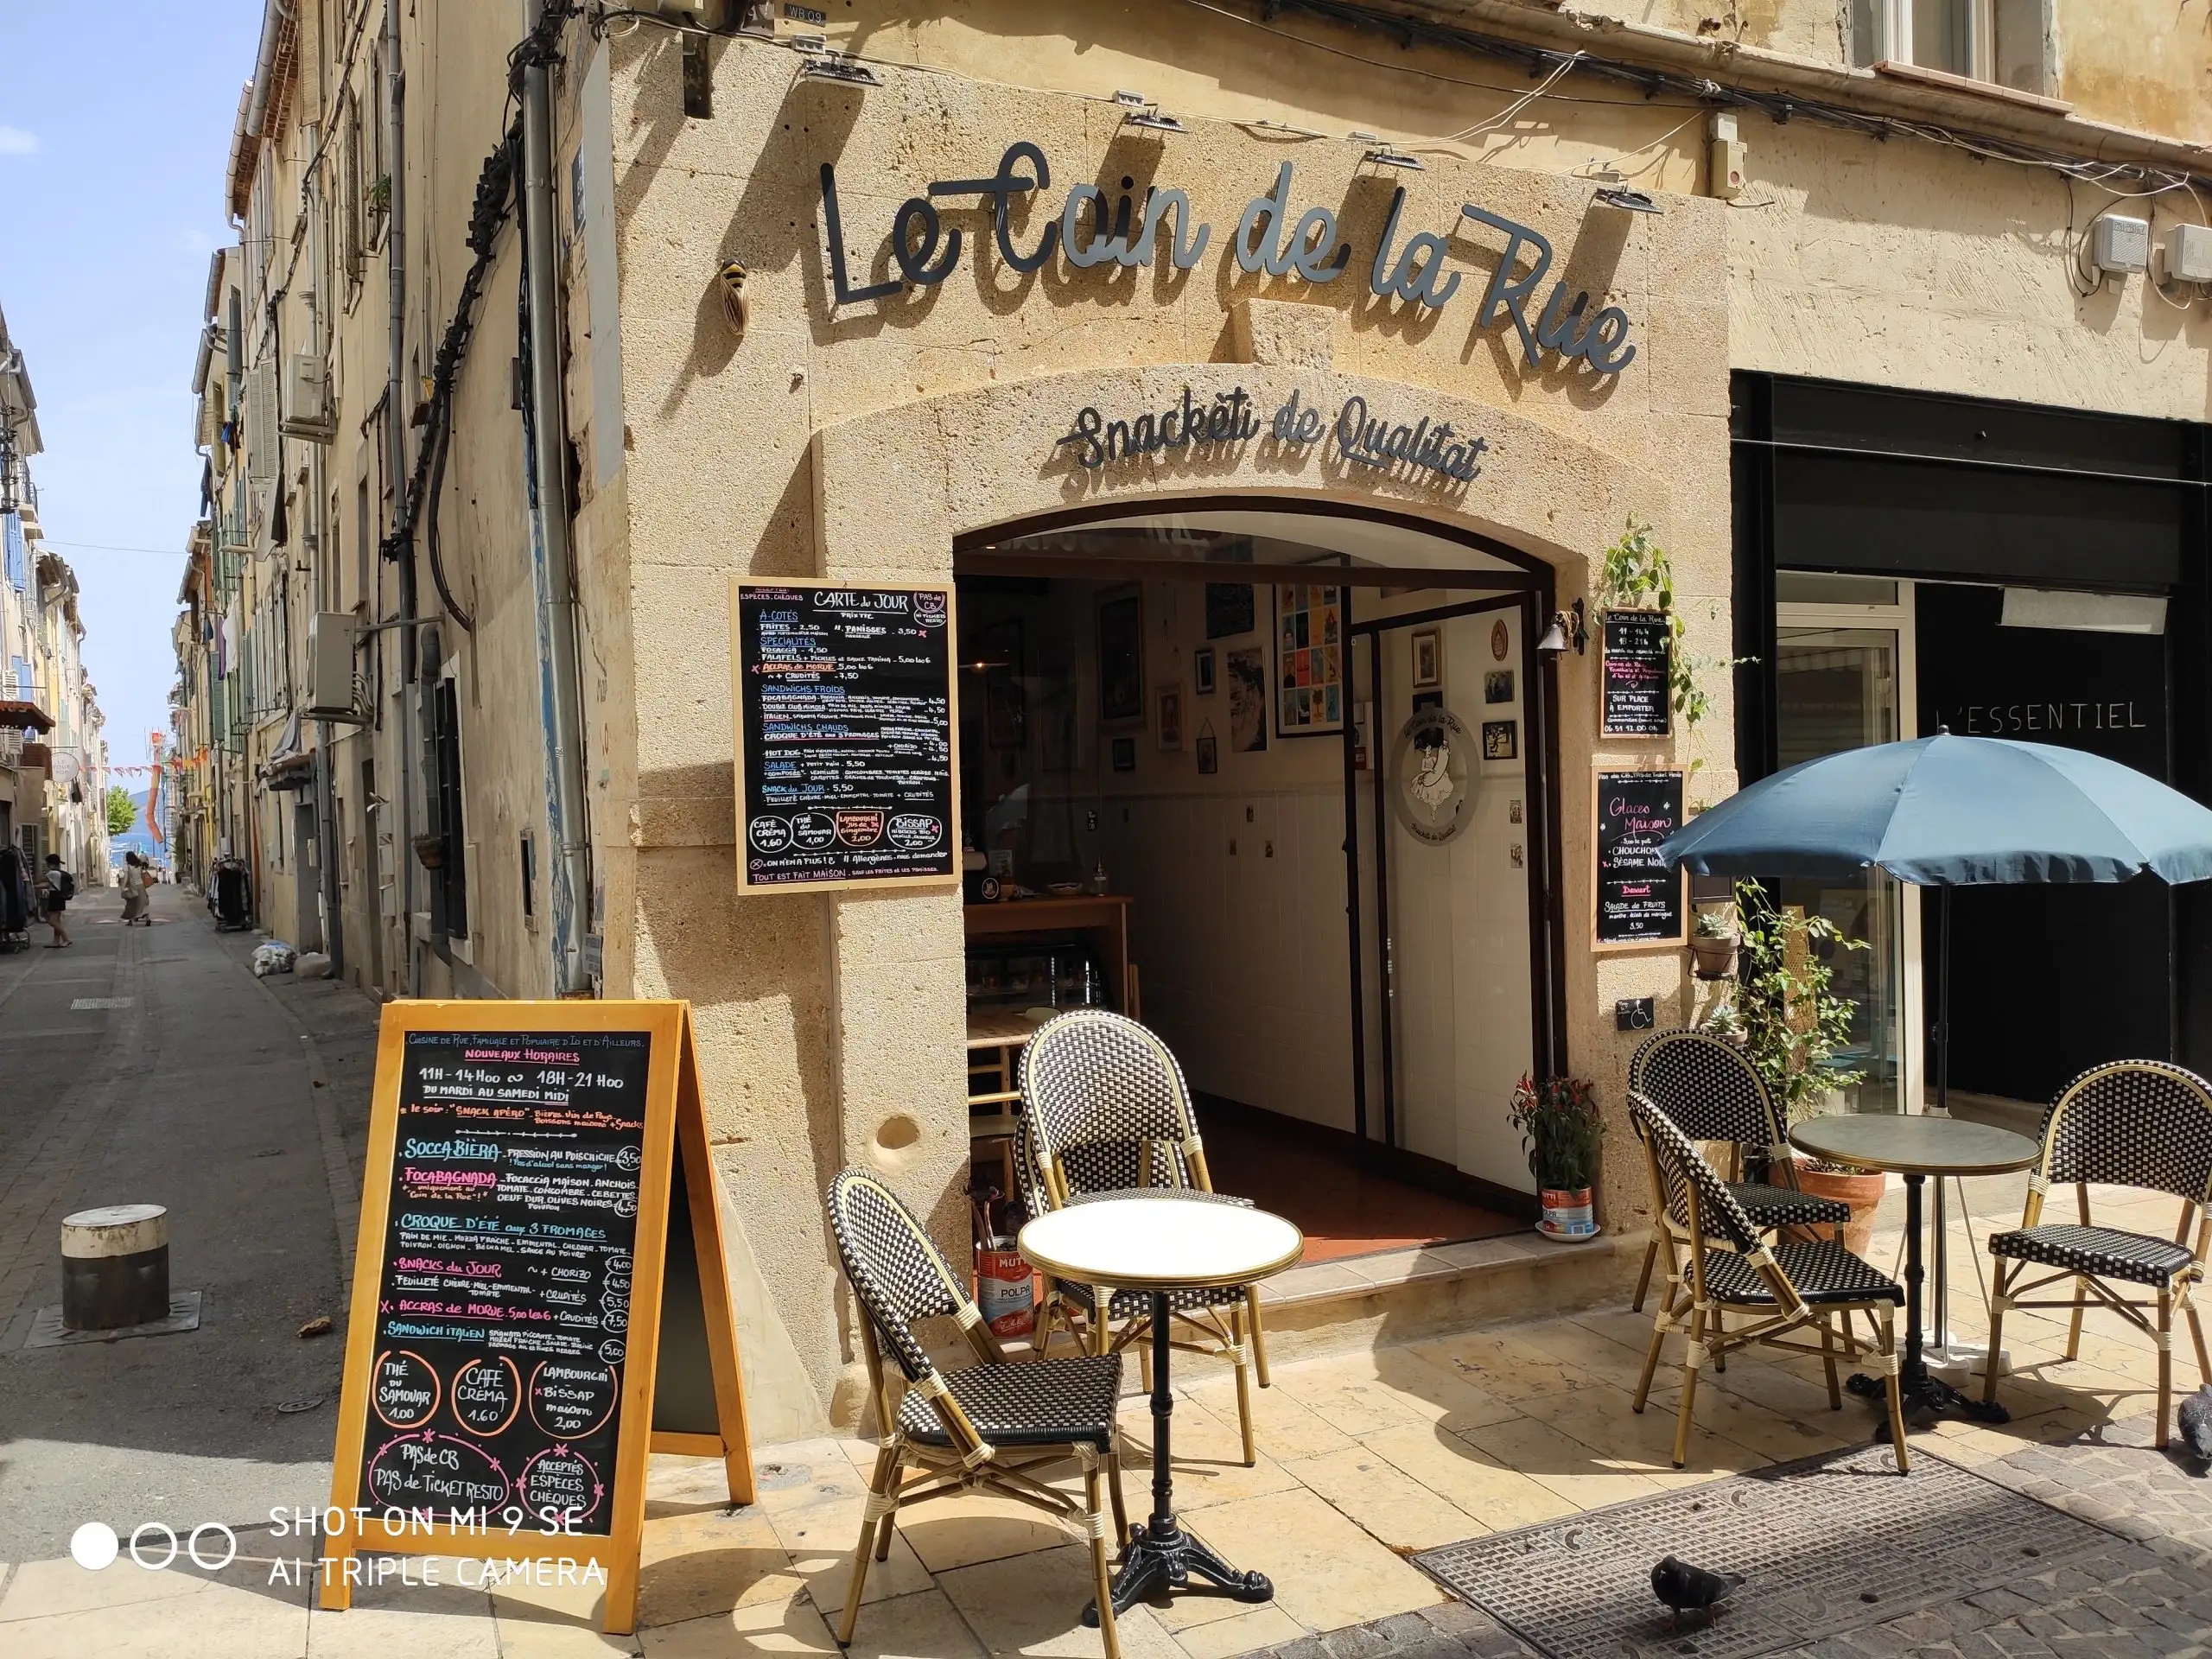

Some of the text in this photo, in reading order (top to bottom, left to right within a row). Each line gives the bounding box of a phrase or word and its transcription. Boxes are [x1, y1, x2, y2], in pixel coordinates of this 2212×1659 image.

[789, 5, 822, 23] WB 09
[820, 141, 1637, 373] Le Coin de la Rue
[1274, 388, 1327, 443] de
[1336, 395, 1489, 482] Qualitat
[814, 591, 860, 608] CARTE
[860, 595, 872, 607] du
[873, 593, 909, 613] JOUR
[918, 593, 932, 601] PAS
[924, 601, 937, 610] CB
[761, 653, 802, 662] FALAFELS
[760, 683, 845, 693] SANDWICHS FROIDS
[1612, 694, 1627, 702] SUR
[1617, 704, 1656, 713] EMPORTER
[762, 722, 849, 733] SANDWICHS CHAUDS
[764, 760, 797, 771] SALADE
[762, 784, 787, 794] SNACK
[800, 783, 826, 792] JOUR
[832, 784, 854, 793] 5,50
[1609, 796, 1650, 817] Glaces
[753, 815, 933, 830] CAFÉ THÉ BISSAP
[1624, 817, 1672, 837] Maison
[1612, 856, 1644, 868] SÉSAME
[752, 868, 847, 882] TOUT EST FAIT MAISON
[1622, 884, 1651, 894] Dessert
[1604, 900, 1630, 913] SALADE
[1642, 899, 1666, 909] FRUITS
[464, 1047, 580, 1065] NOUVEAUX HORAIRES
[423, 1084, 569, 1102] DU MARDI AU SAMEDI MIDI
[410, 1103, 422, 1113] le
[404, 1137, 452, 1162] SOCCA
[550, 1150, 563, 1161] AU
[404, 1166, 498, 1190] FOCABAGNADA
[416, 1185, 463, 1193] uniquement
[546, 1195, 580, 1206] OLIVES
[401, 1213, 463, 1230] CROQUE
[505, 1224, 526, 1236] aux
[529, 1222, 539, 1235] 3
[541, 1224, 607, 1239] FROMAGES
[398, 1256, 592, 1280] SNACKS du JOUR CHORIZO
[395, 1274, 440, 1287] FEUILLETÉ
[399, 1299, 443, 1314] ACCRAS
[445, 1303, 463, 1314] de
[467, 1303, 505, 1318] MORUE
[387, 1320, 485, 1343] SANDWICH ITALIEN
[385, 1360, 410, 1377] THÉ
[465, 1363, 504, 1388] CAFÉ
[378, 1386, 432, 1408] SAMOVAR
[543, 1385, 595, 1402] BISSAP
[545, 1403, 593, 1416] maison
[400, 1443, 460, 1471] PAS de CB
[537, 1459, 584, 1476] ACCEPTÉS
[373, 1468, 585, 1503] PAS de TICKET RESTO ESPÈCES
[529, 1489, 588, 1509] CHÈQUES
